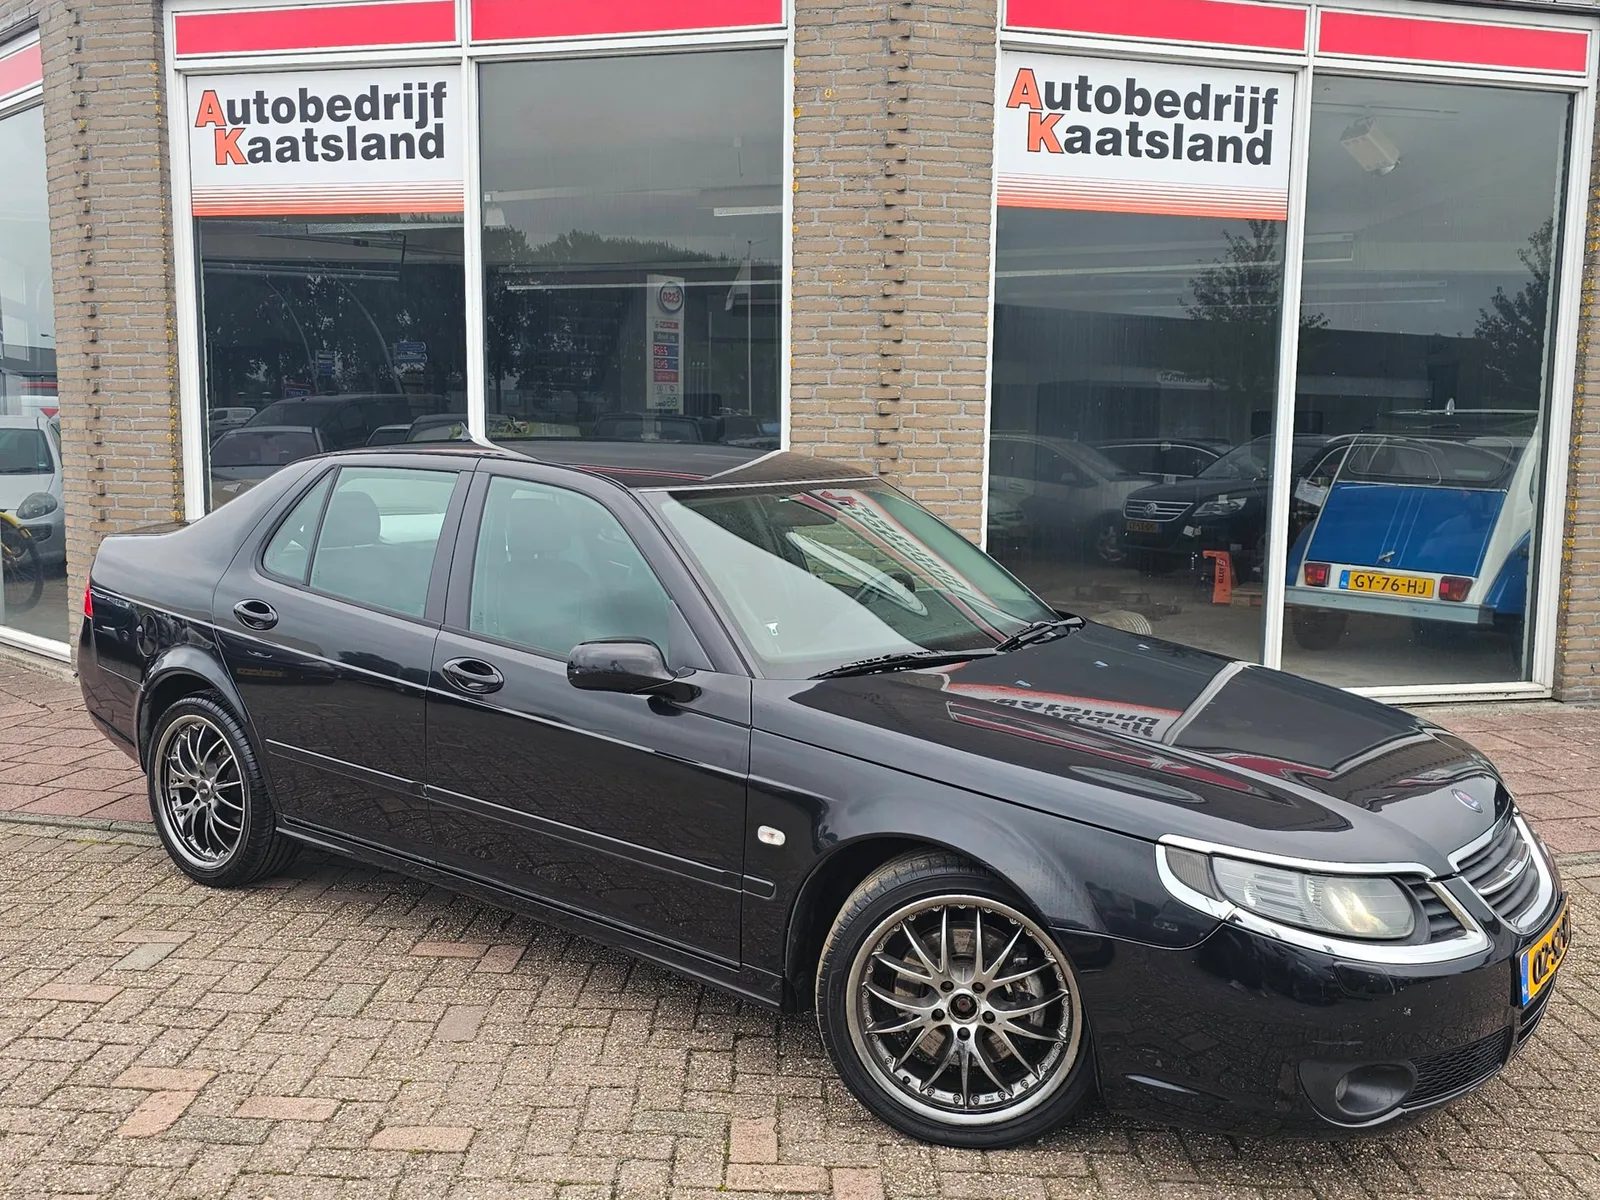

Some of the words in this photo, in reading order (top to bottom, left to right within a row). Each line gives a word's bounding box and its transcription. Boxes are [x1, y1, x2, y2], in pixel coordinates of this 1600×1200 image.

[195, 81, 447, 129] Autobedrijf
[1006, 67, 1279, 134] Autobedrijf
[214, 122, 445, 165] Kaatsland
[1027, 111, 1273, 165] Kaatsland
[1354, 574, 1427, 595] GY-76-HJ
